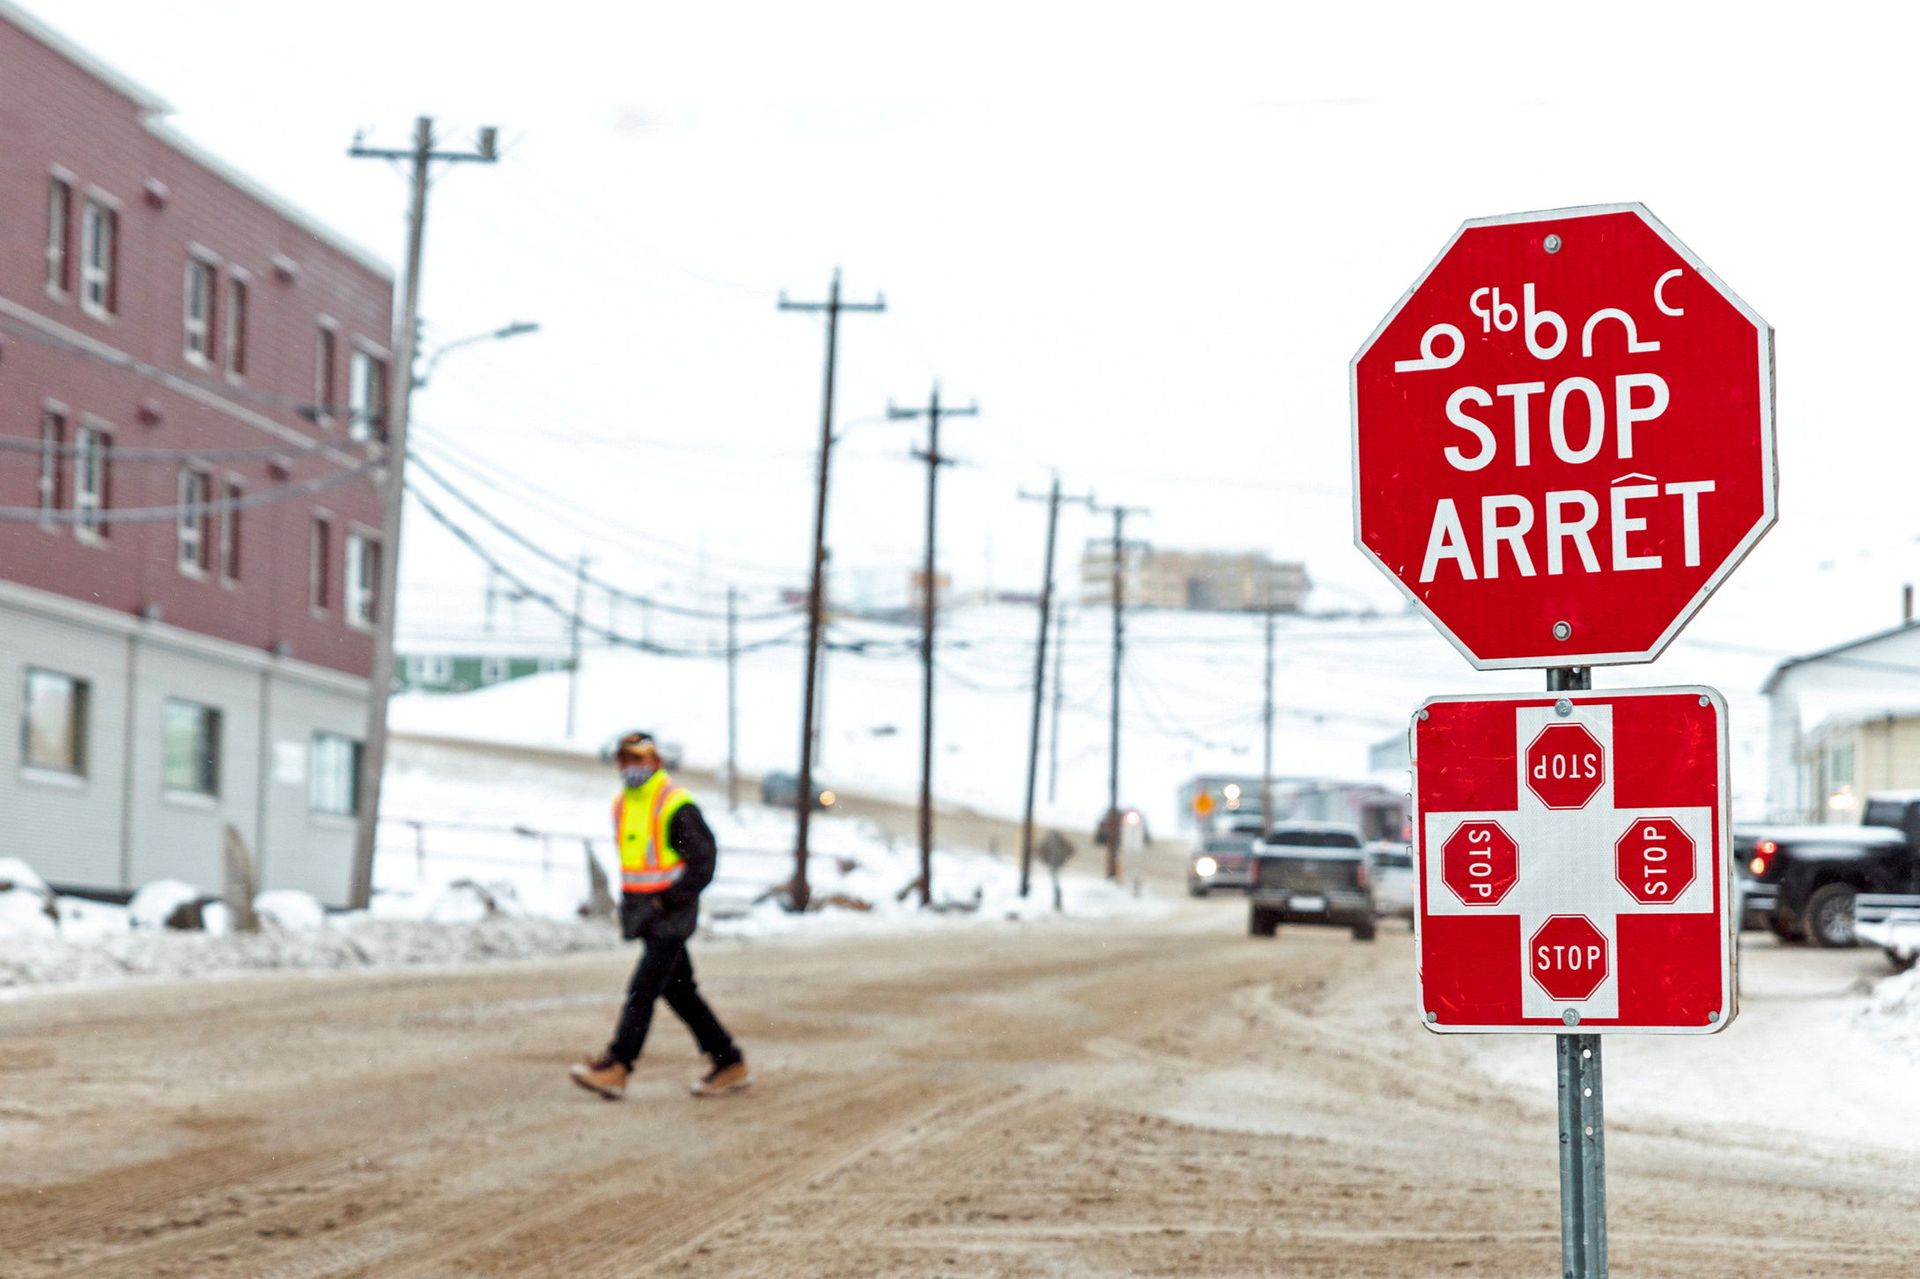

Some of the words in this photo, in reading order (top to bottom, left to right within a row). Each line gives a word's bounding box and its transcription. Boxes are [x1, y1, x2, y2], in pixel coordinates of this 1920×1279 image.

[1444, 373, 1669, 471] STOP
[1419, 473, 1715, 582] ARRÊT
[1533, 754, 1597, 780] STOP
[1468, 829, 1492, 898] STOP
[1643, 826, 1668, 896] STOP
[1537, 945, 1601, 971] STOP
